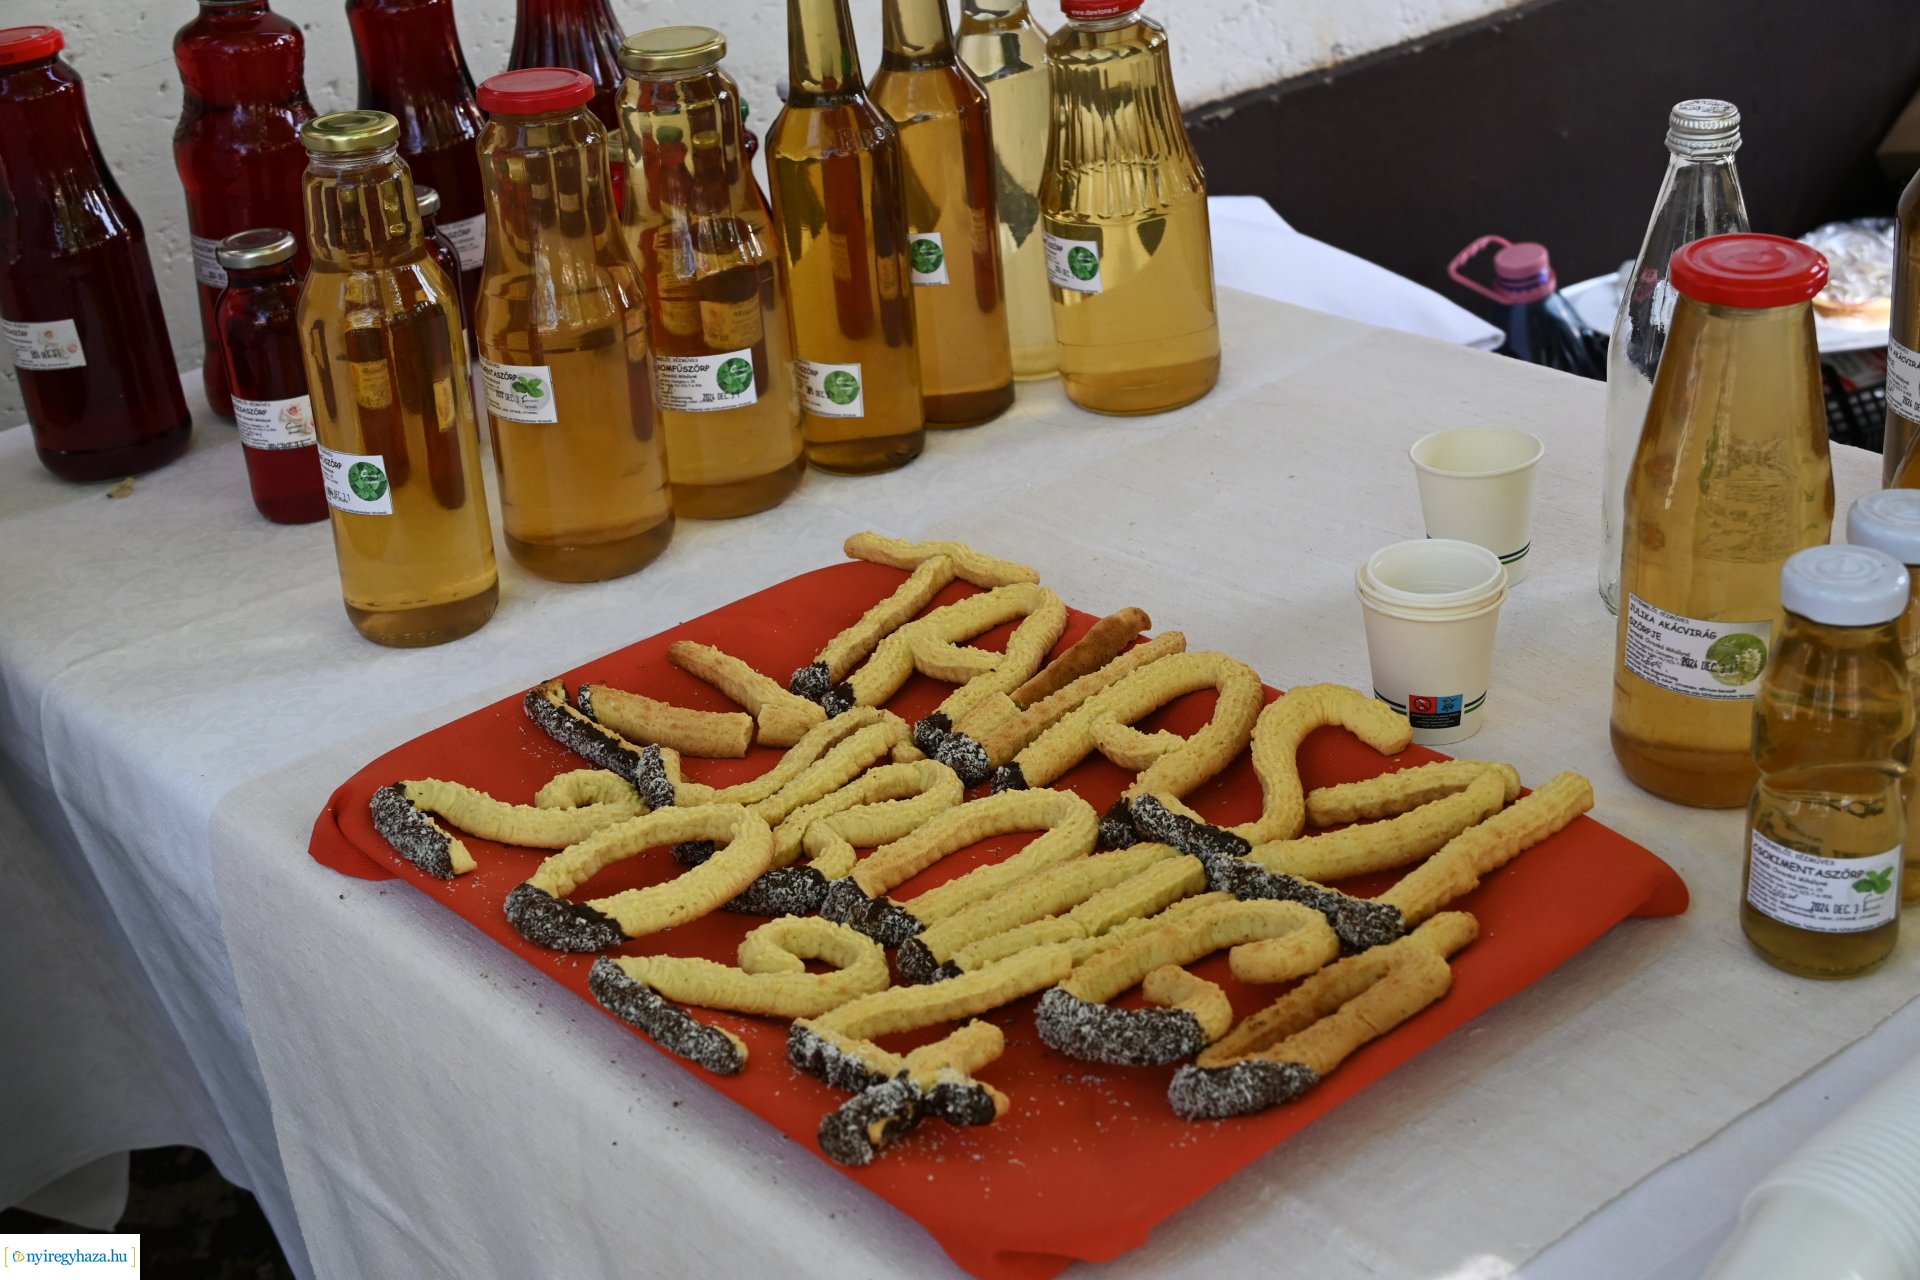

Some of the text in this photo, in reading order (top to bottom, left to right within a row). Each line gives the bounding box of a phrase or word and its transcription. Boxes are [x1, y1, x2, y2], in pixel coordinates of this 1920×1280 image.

[1630, 602, 1717, 640] JULIKA AKÁCVIRÁG
[1681, 656, 1698, 669] 2024
[1811, 901, 1829, 914] 2024
